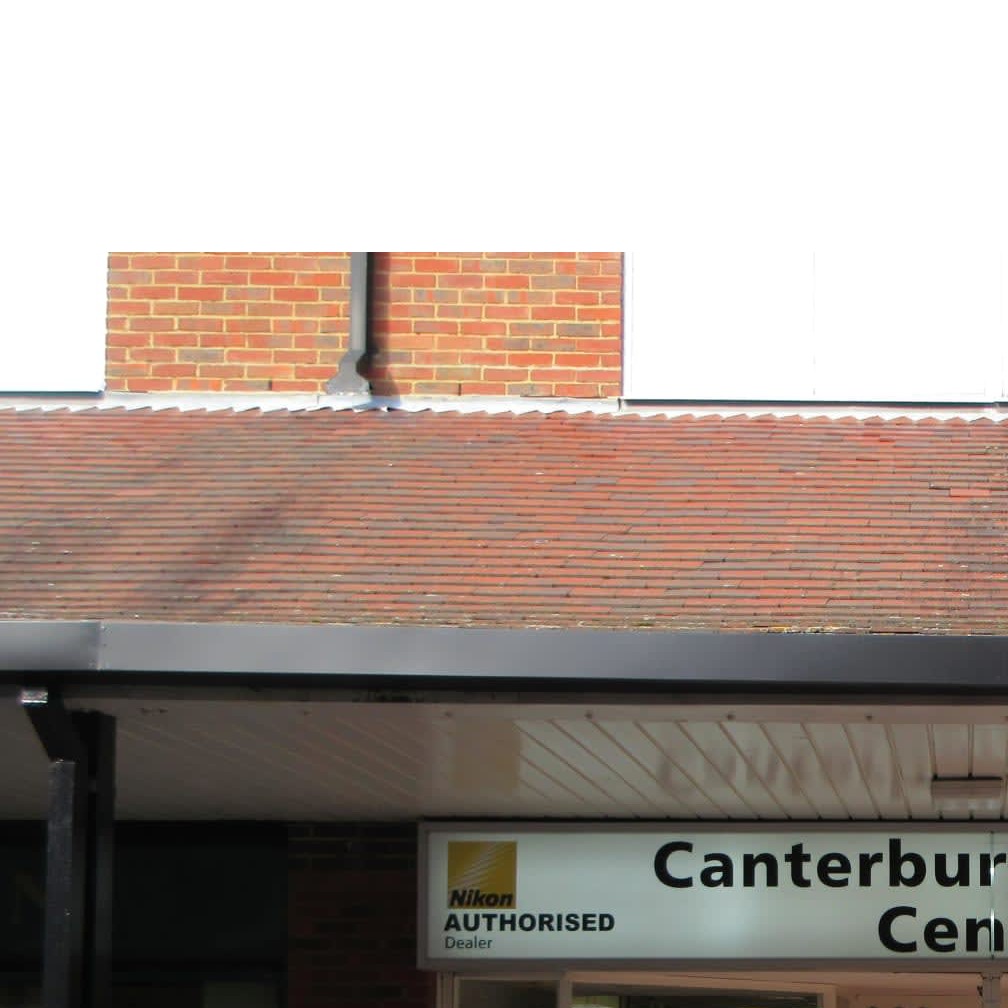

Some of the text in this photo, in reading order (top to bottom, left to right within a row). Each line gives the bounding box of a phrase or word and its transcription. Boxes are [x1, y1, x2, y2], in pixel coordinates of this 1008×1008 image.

[448, 889, 514, 908] Nikon
[443, 913, 615, 932] AUTHORISED
[444, 936, 493, 950] Dealer
